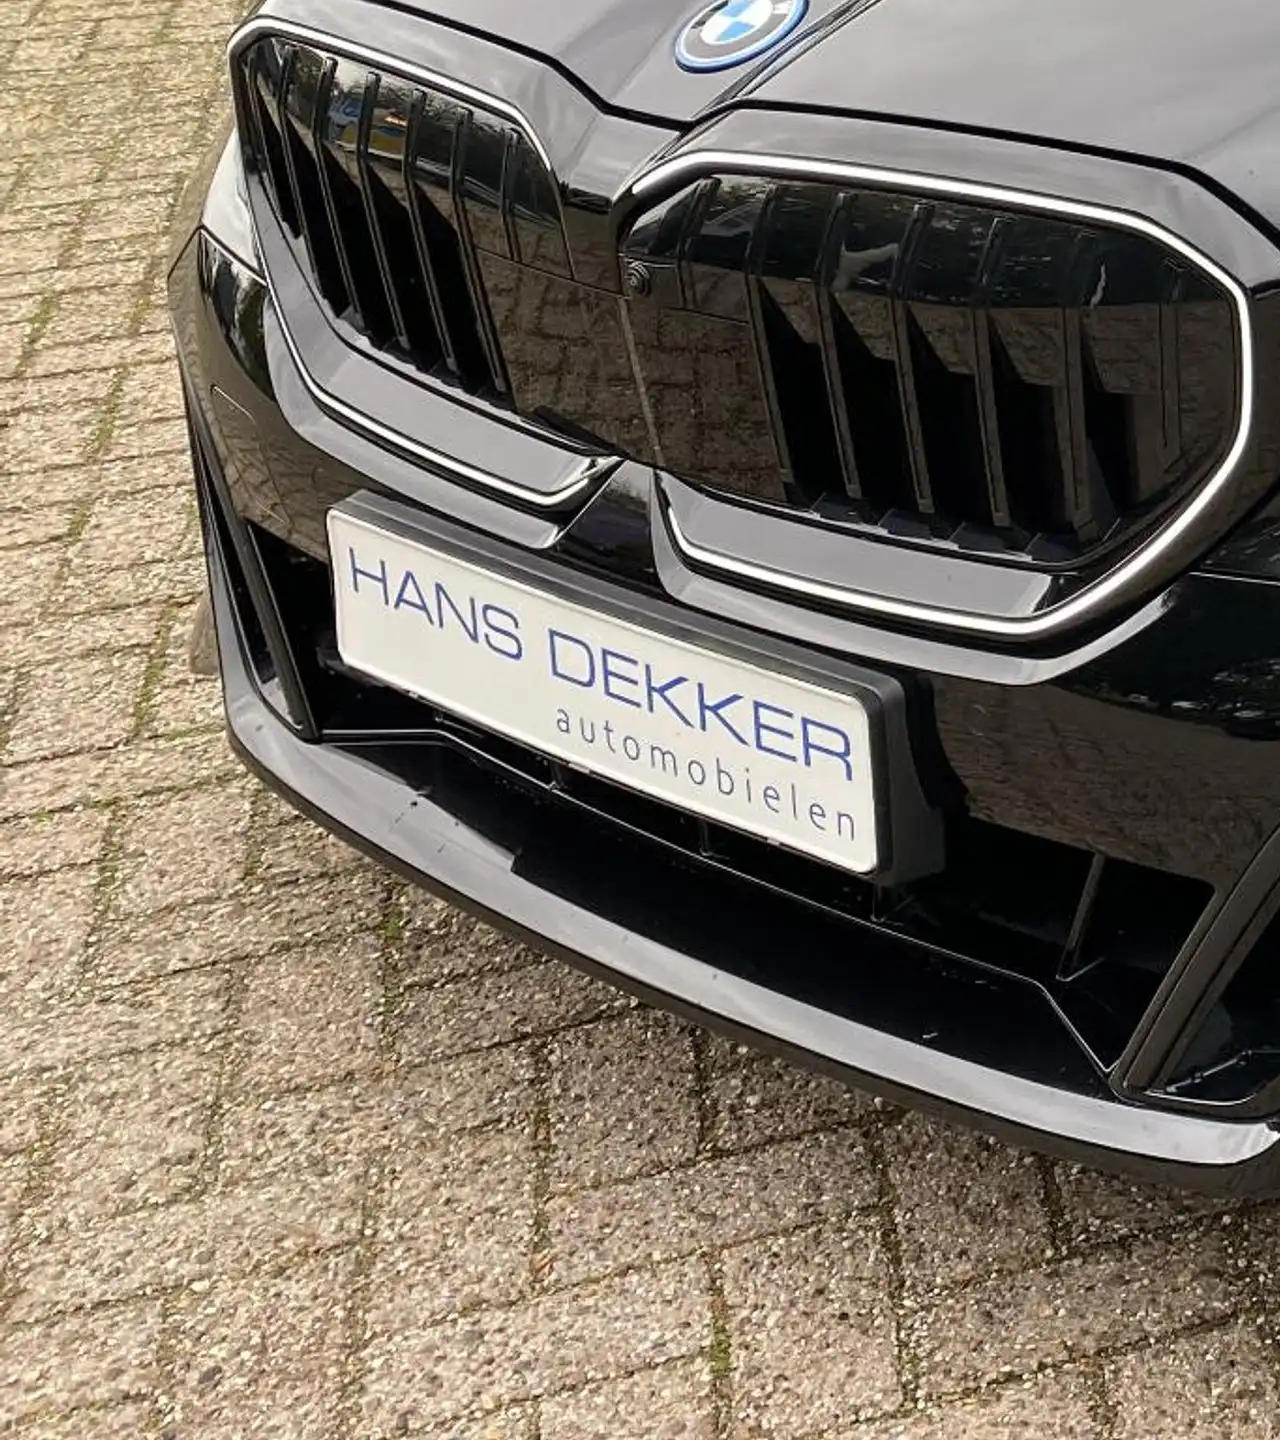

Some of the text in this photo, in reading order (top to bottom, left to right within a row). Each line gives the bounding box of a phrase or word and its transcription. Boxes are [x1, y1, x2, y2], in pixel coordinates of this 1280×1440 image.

[350, 546, 853, 782] HANS DEKKER
[556, 707, 856, 842] automobielen
